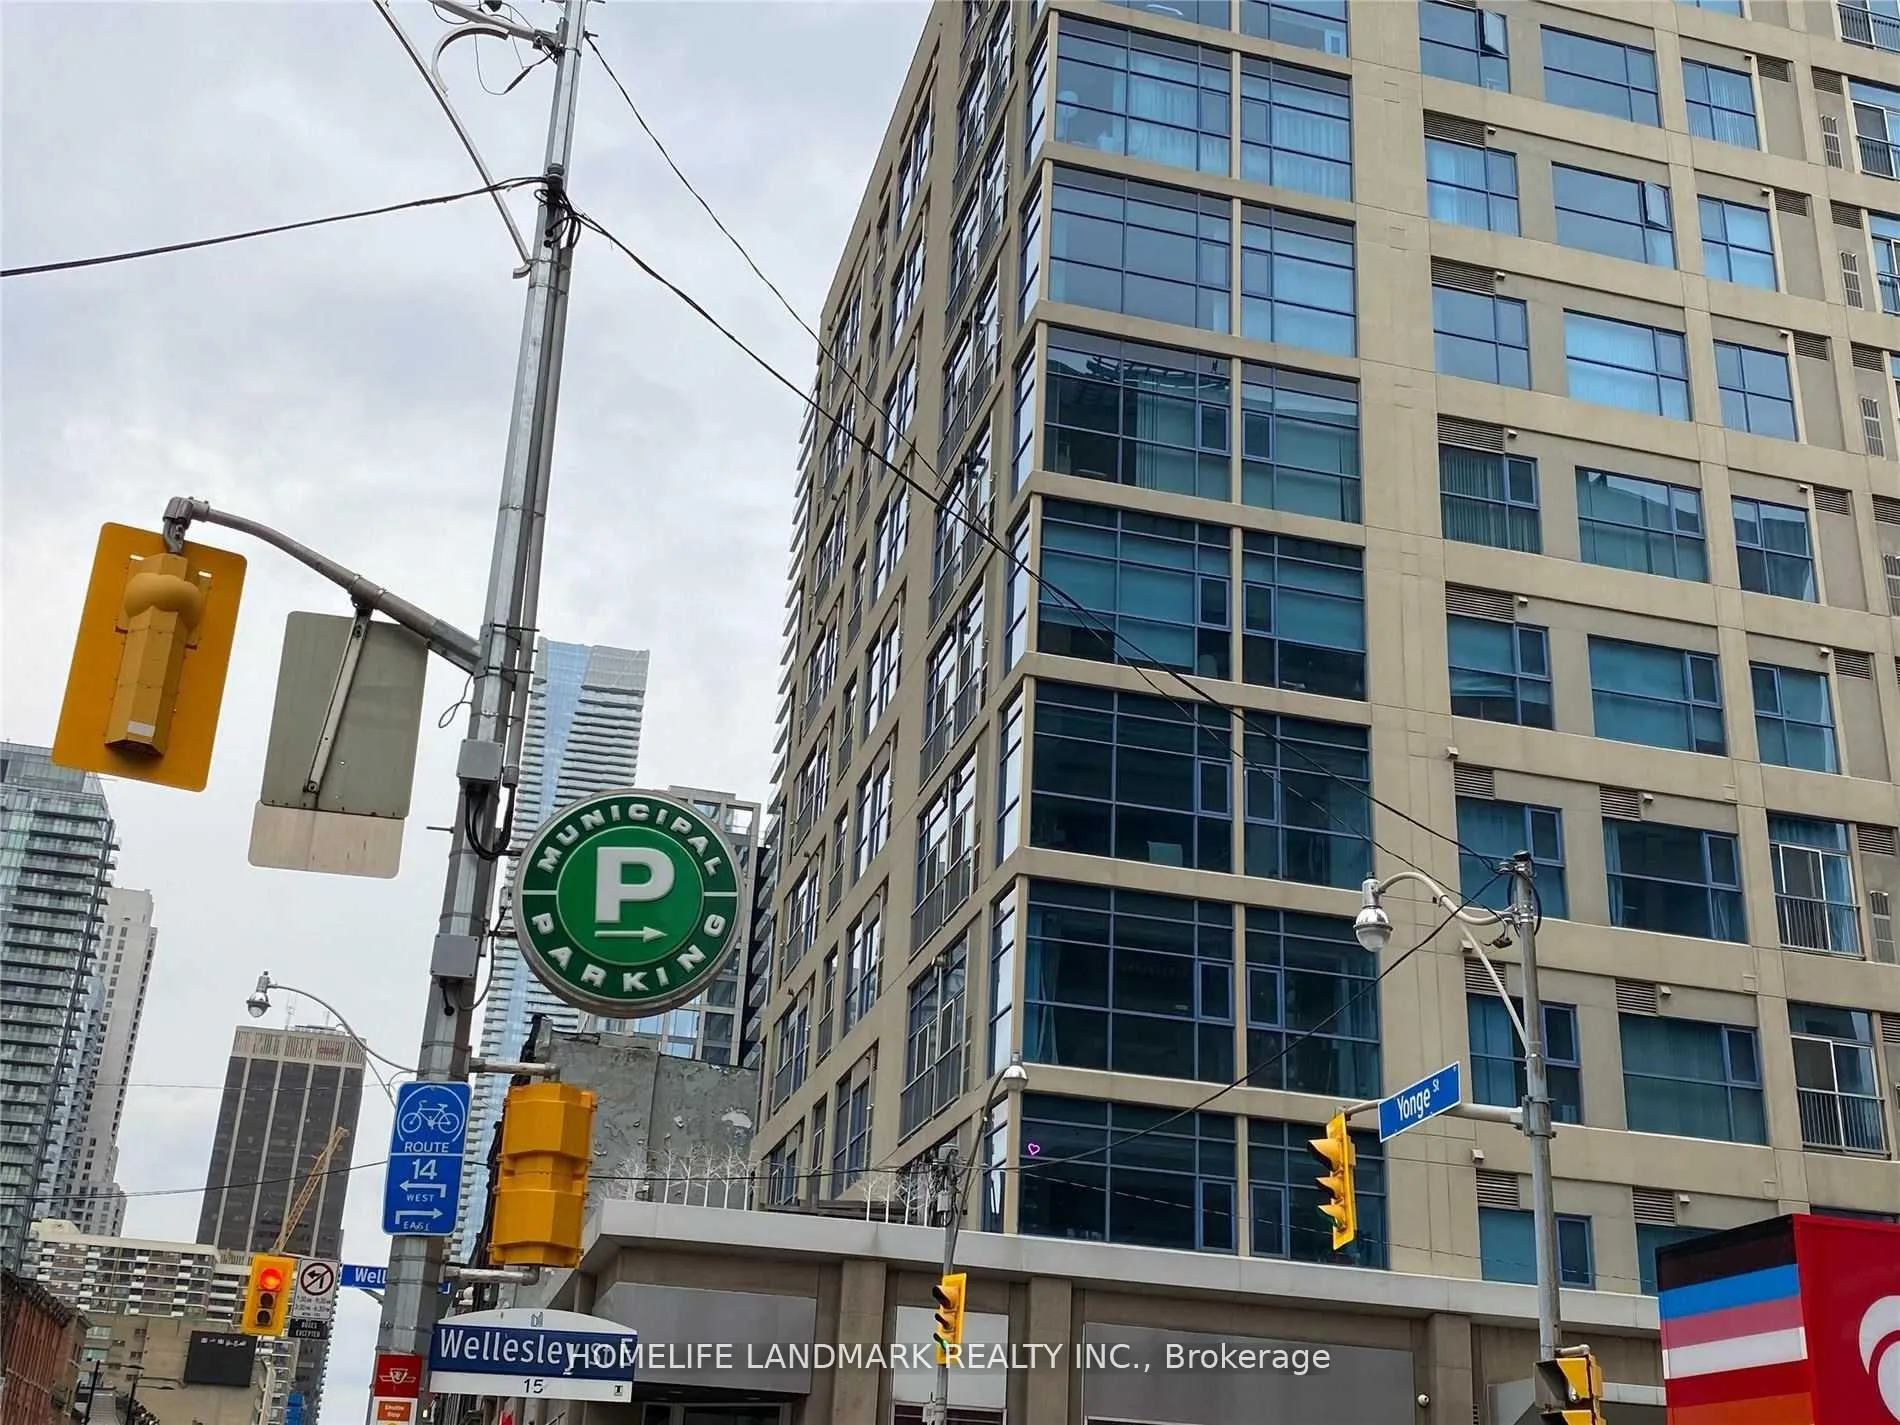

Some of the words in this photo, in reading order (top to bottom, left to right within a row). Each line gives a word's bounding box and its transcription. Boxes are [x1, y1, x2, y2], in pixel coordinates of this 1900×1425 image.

[537, 803, 723, 877] MUNICIPAL
[595, 846, 675, 924] P
[531, 912, 726, 992] PARKING
[1397, 1088, 1431, 1121] Yonge
[1432, 1078, 1440, 1093] St
[404, 1141, 450, 1153] ROUTE
[412, 1158, 437, 1180] 14
[406, 1193, 434, 1203] WEST
[440, 1328, 582, 1375] Wellesley
[524, 1378, 544, 1395] 15
